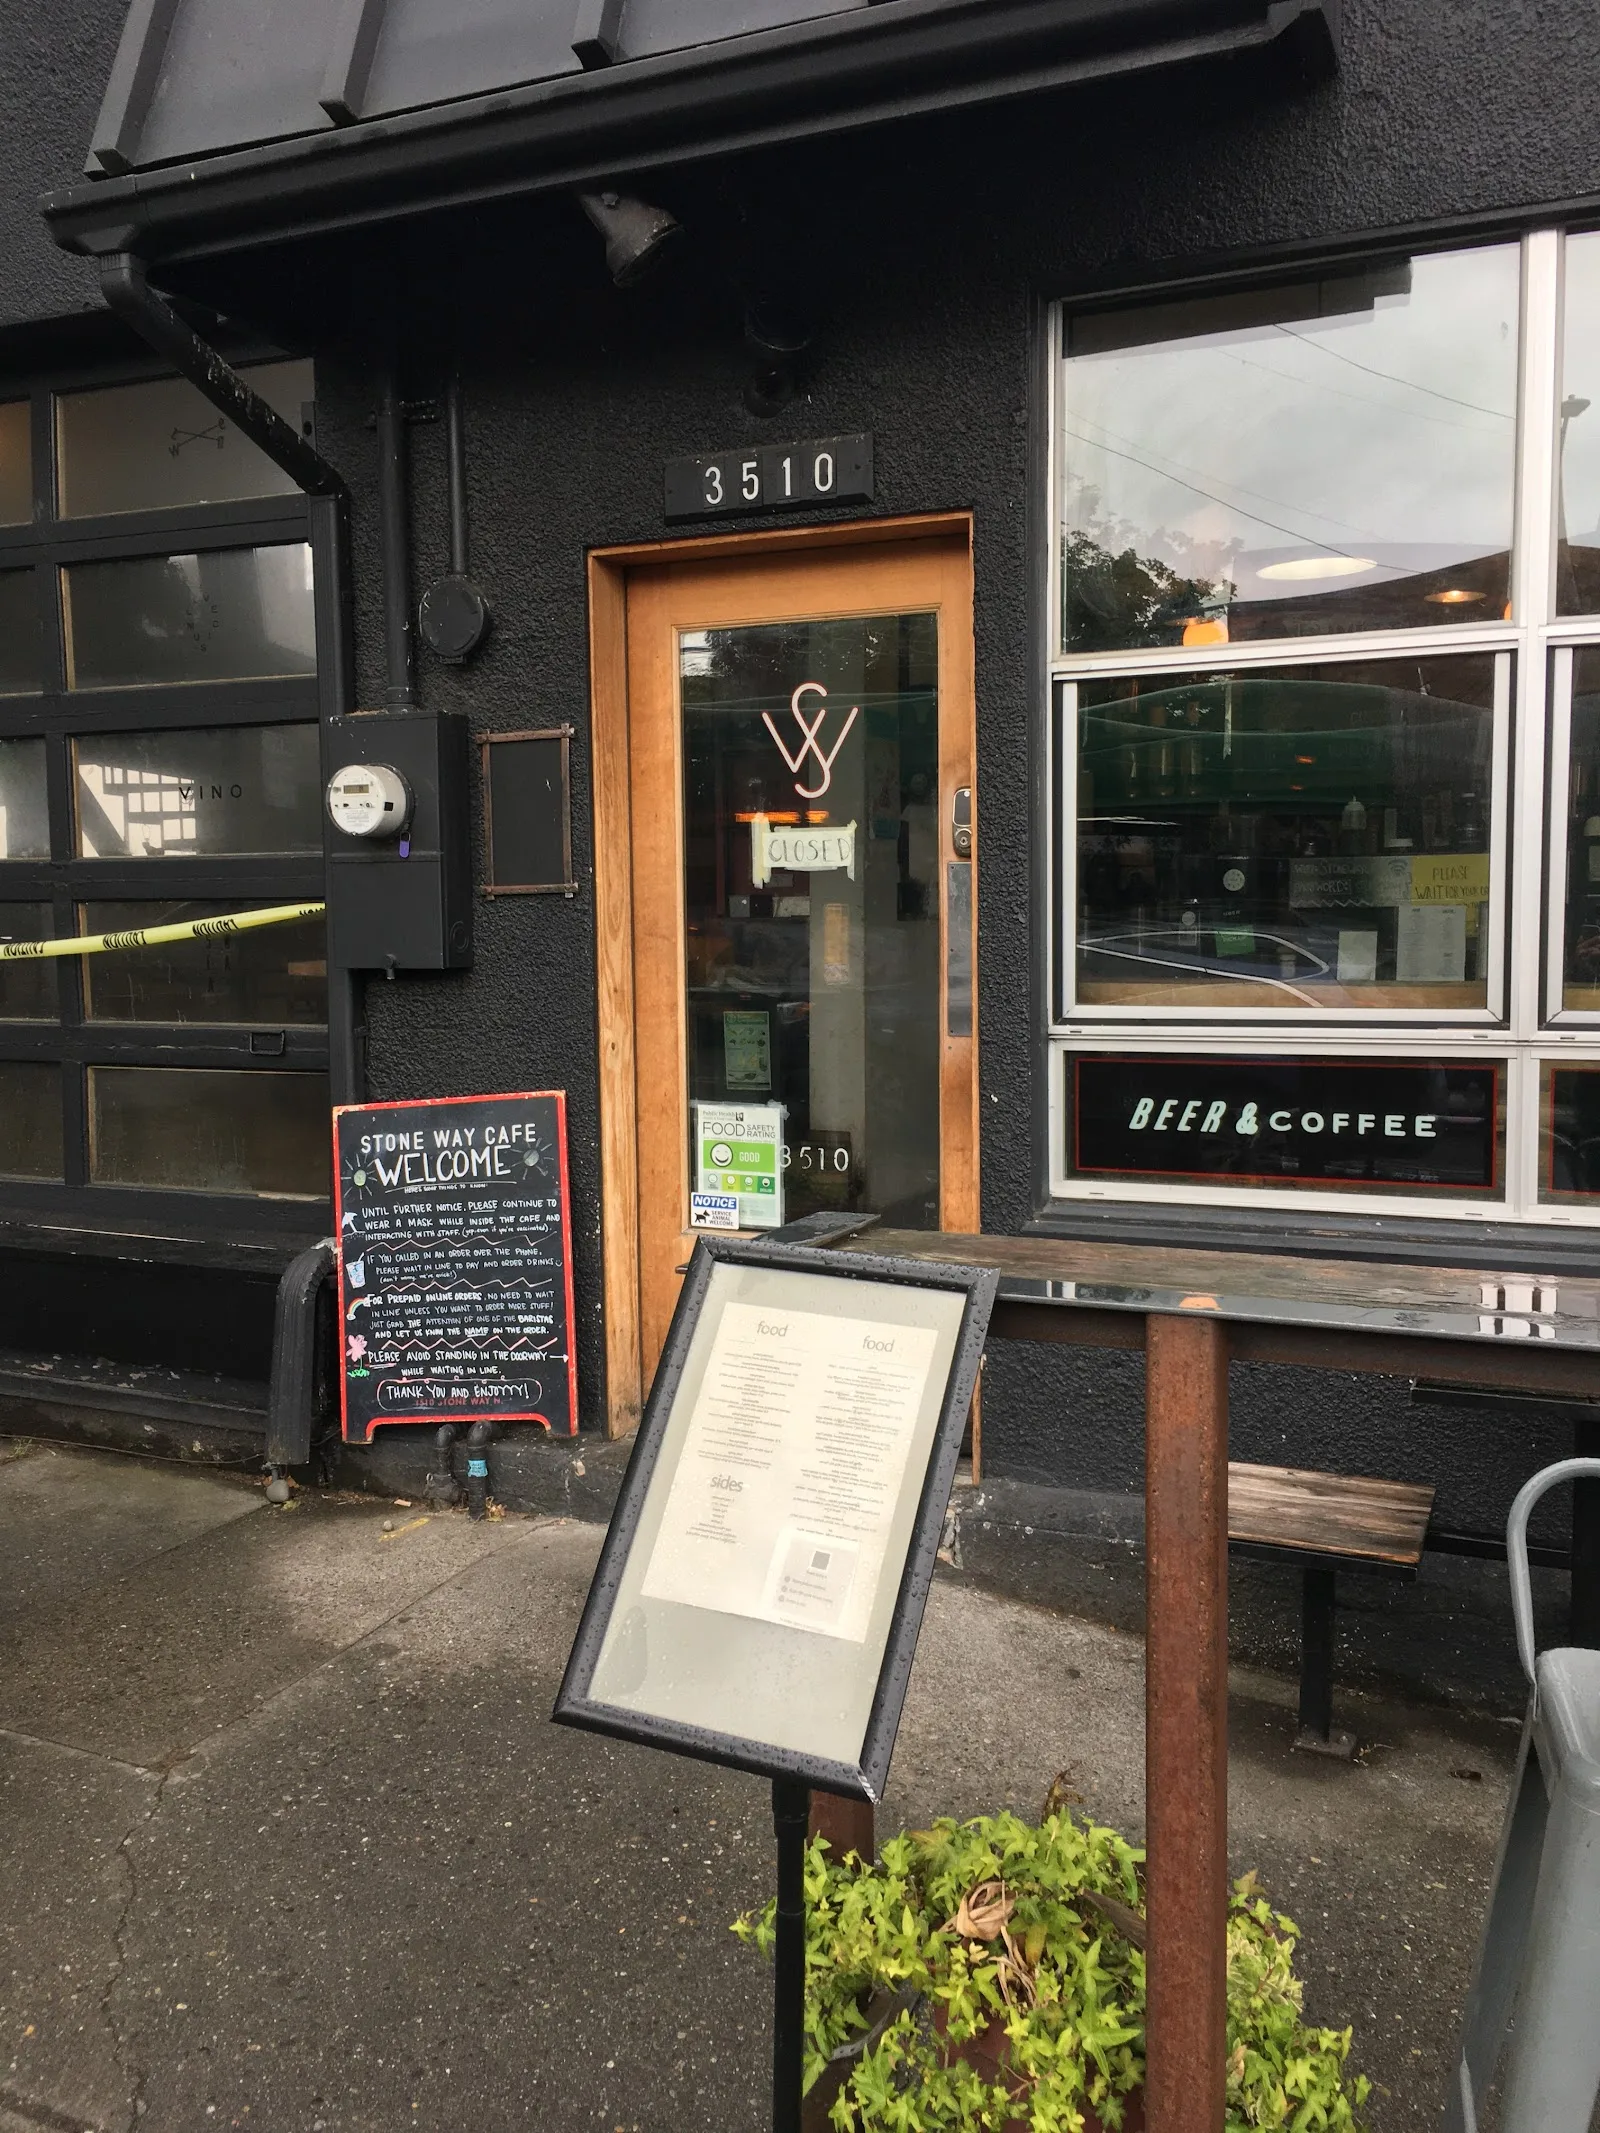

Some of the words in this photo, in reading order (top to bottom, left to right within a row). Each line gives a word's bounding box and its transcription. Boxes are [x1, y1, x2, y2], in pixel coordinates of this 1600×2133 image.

[705, 453, 833, 504] 3510
[179, 784, 243, 801] VINO
[768, 838, 851, 863] CLOSED
[1415, 885, 1443, 899] WAIT
[1128, 1098, 1227, 1133] BEER
[1236, 1102, 1258, 1134] &
[1269, 1111, 1436, 1137] COFFEE
[703, 1121, 745, 1136] FOOD
[361, 1131, 424, 1153] STONE
[433, 1128, 475, 1149] WAY
[485, 1123, 536, 1145] CAFE
[374, 1145, 511, 1186] WELCOME
[740, 1152, 760, 1163] GOOD
[362, 1207, 389, 1218] UNTIL
[393, 1203, 432, 1215] FURTHER
[468, 1200, 498, 1211] PLEASE
[502, 1199, 544, 1208] CONTINUE
[546, 1199, 557, 1208] TO
[694, 1195, 736, 1208] NOTICE
[364, 1220, 390, 1230] WEAR
[396, 1218, 402, 1228] A
[408, 1218, 433, 1227] MASK
[469, 1217, 494, 1225] INSIDE
[499, 1216, 515, 1224] THE
[519, 1214, 541, 1223] CAFE
[546, 1214, 560, 1222] AND
[365, 1230, 412, 1241] INTERACTING
[416, 1230, 435, 1238] WITH
[366, 1255, 375, 1265] IF
[378, 1254, 392, 1263] YOU
[395, 1252, 419, 1262] CALLED
[448, 1249, 471, 1258] ORDER
[474, 1248, 492, 1257] OVER
[375, 1266, 400, 1275] PLEASE
[403, 1264, 422, 1274] WAIT
[435, 1262, 451, 1270] LINE
[465, 1261, 480, 1270] PAY
[483, 1260, 498, 1268] AND
[501, 1259, 523, 1267] ORDER
[526, 1258, 554, 1266] DRINKS
[366, 1294, 383, 1305] FOR
[387, 1294, 421, 1304] PREPAID
[425, 1292, 452, 1302] ONLINE
[487, 1292, 498, 1300] NO
[500, 1291, 520, 1300] NEED
[523, 1291, 532, 1299] TO
[535, 1290, 554, 1298] WAIT
[371, 1310, 380, 1318] IN
[382, 1308, 400, 1317] LINE
[404, 1306, 430, 1316] UNLESS
[434, 1305, 448, 1314] YOU
[450, 1304, 470, 1313] WANT
[475, 1304, 483, 1312] TO
[485, 1302, 505, 1311] ORDER
[508, 1302, 527, 1310] MORE
[530, 1301, 554, 1311] STUFF!
[369, 1320, 384, 1330] JUST
[386, 1320, 404, 1328] GRAB
[407, 1319, 421, 1328] THE
[425, 1317, 461, 1325] ATTENTION
[517, 1314, 553, 1324] BARISTAS
[757, 1320, 788, 1337] food
[375, 1330, 391, 1338] AND
[396, 1330, 410, 1338] LET
[425, 1328, 443, 1336] KNOW
[464, 1326, 489, 1336] NAME
[492, 1326, 503, 1334] ON
[862, 1333, 895, 1355] food
[368, 1351, 400, 1363] PLEASE
[406, 1351, 431, 1361] AVOID
[435, 1350, 477, 1361] STANDING
[480, 1351, 489, 1360] IN
[493, 1350, 509, 1360] THE
[510, 1350, 548, 1361] DOORWAY
[401, 1367, 424, 1376] WHILE
[430, 1365, 464, 1375] WAITING
[386, 1385, 424, 1400] THANK
[426, 1384, 446, 1398] YOU
[451, 1387, 469, 1399] AND
[710, 1473, 744, 1492] sides
